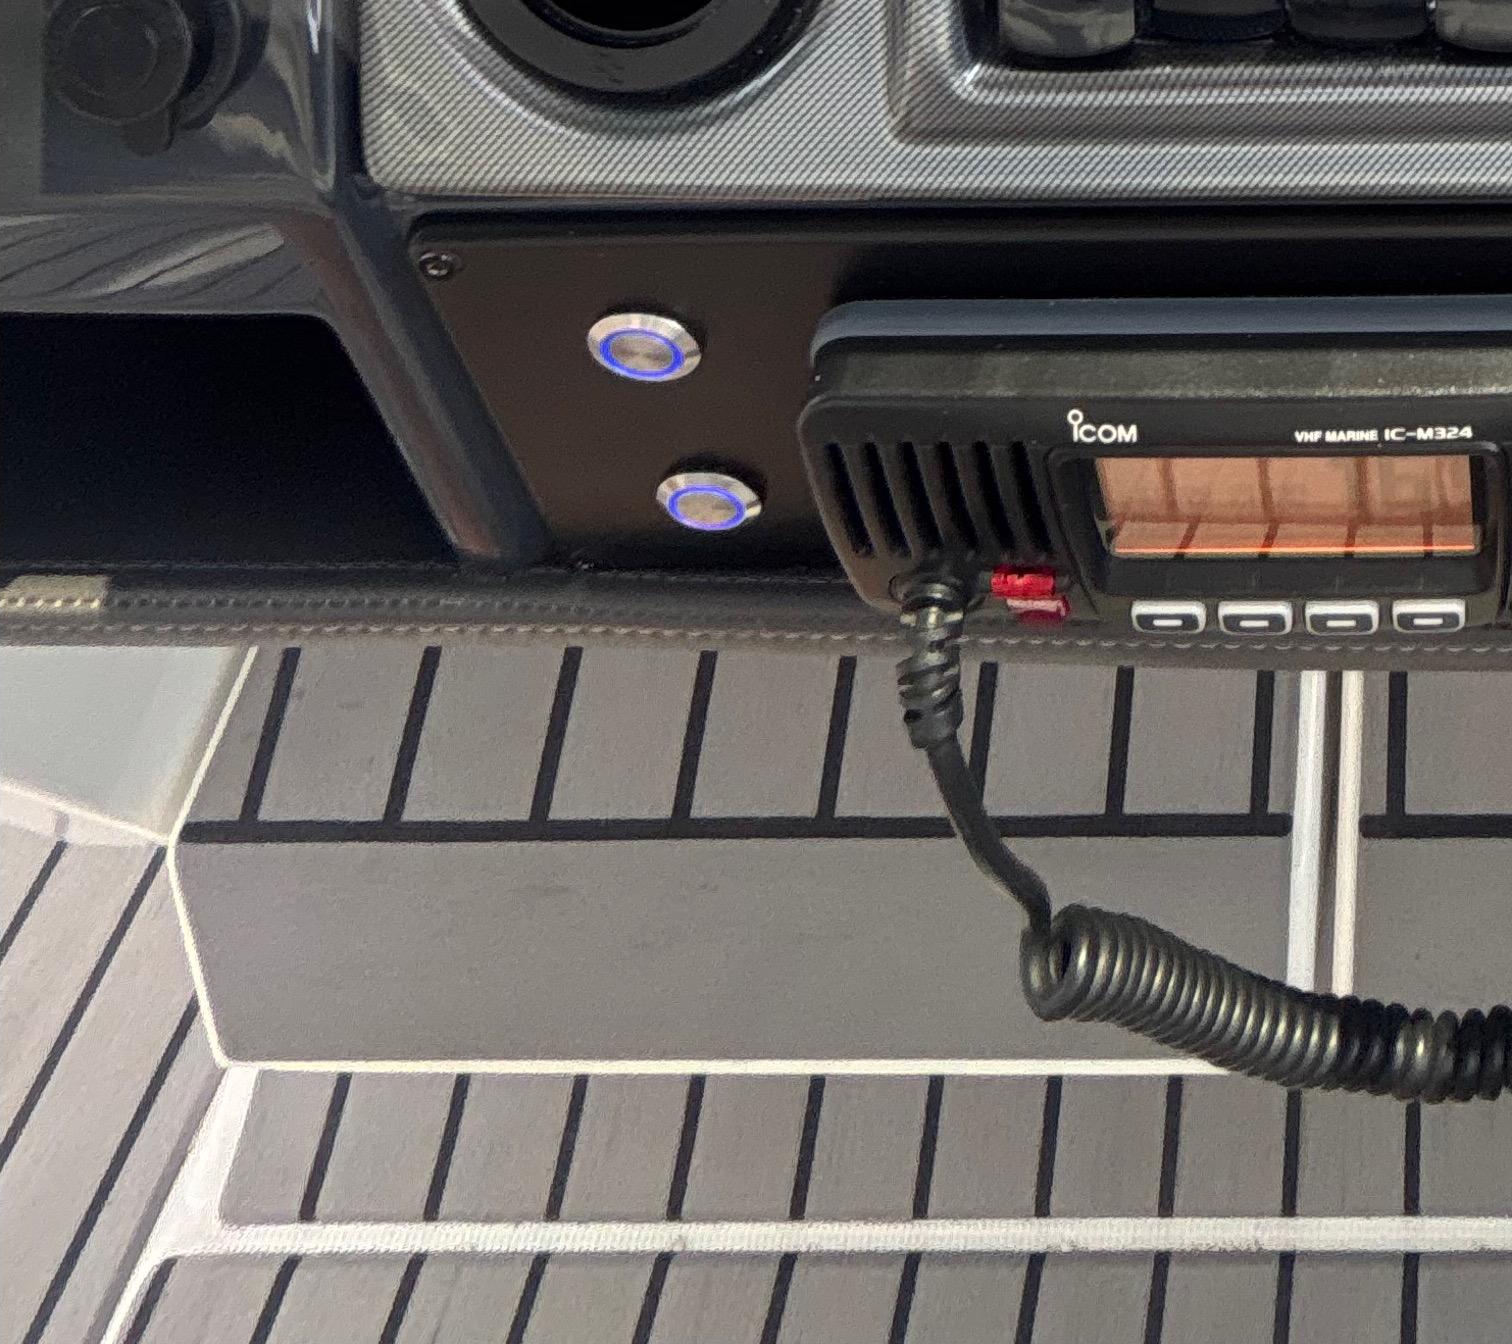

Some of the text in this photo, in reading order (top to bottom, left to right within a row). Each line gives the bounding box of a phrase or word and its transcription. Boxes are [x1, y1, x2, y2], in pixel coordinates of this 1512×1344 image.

[1294, 426, 1473, 443] VHF MARINE IC-M324
